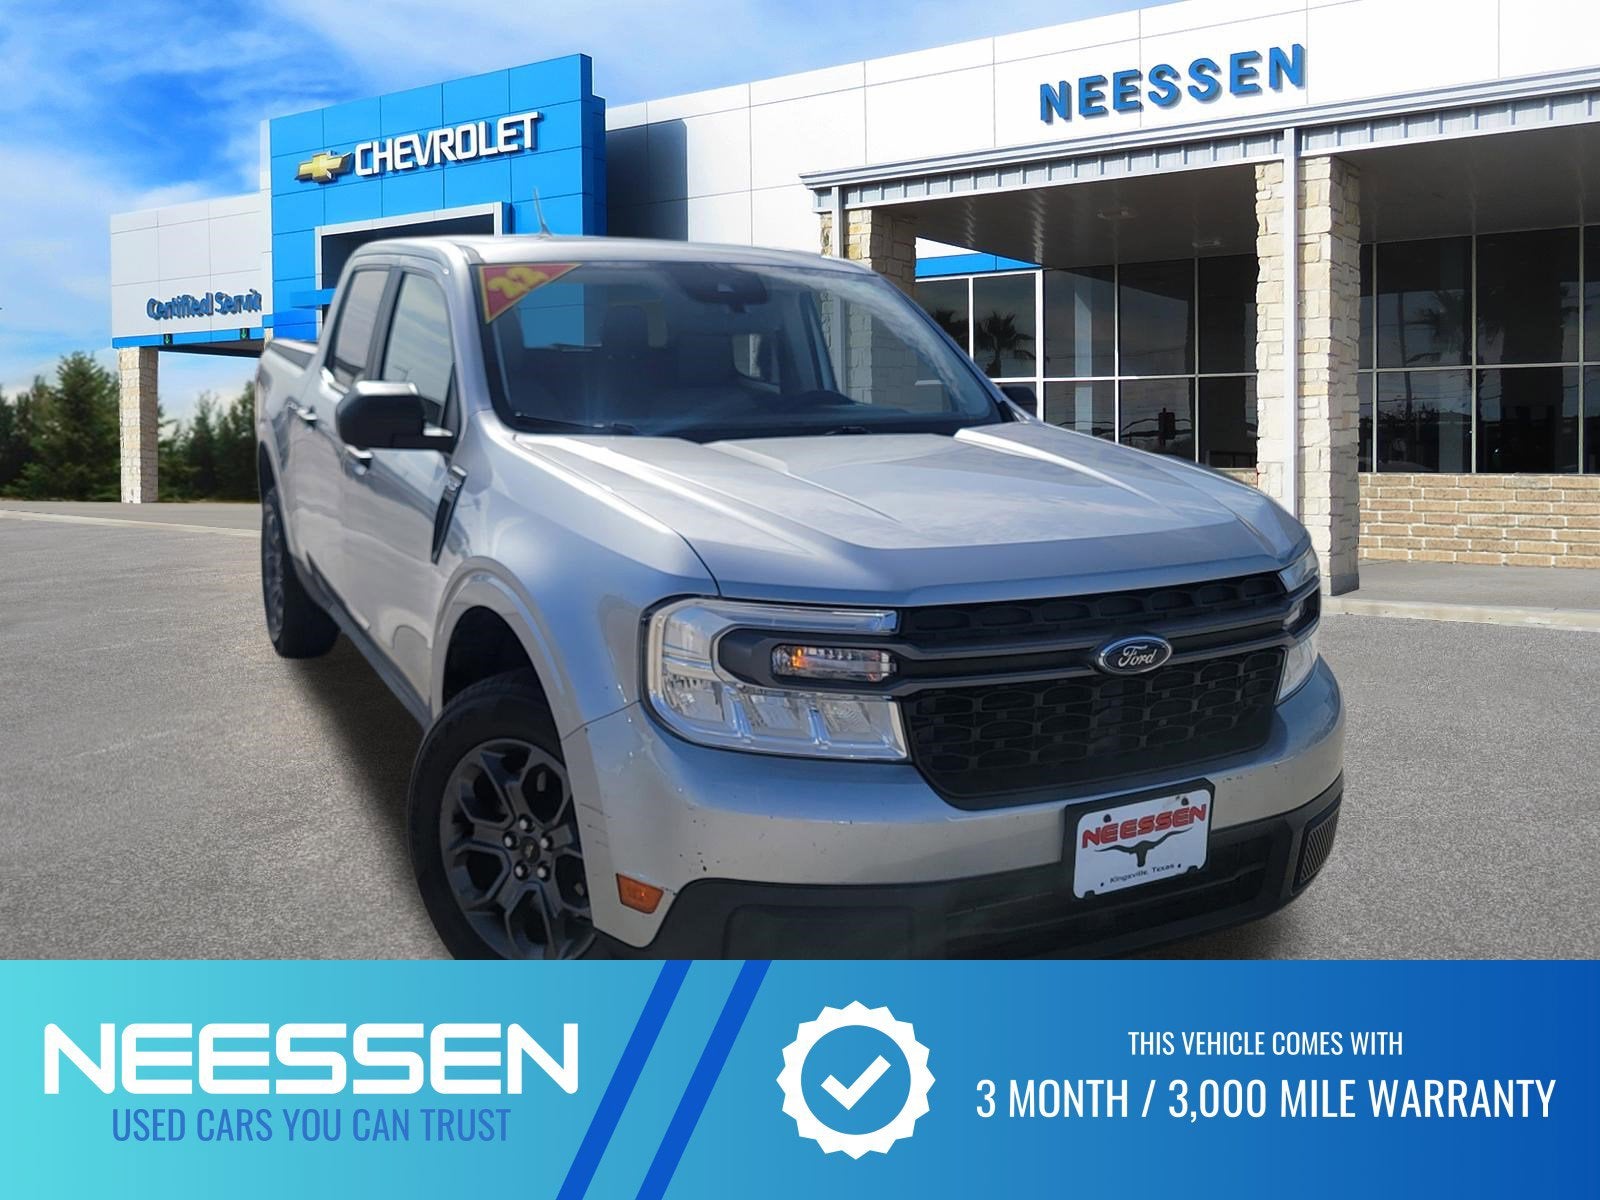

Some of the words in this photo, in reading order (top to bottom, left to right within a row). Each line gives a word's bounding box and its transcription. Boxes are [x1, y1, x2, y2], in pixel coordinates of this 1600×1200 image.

[1039, 43, 1305, 124] NEESSEN
[354, 110, 541, 177] CHEVROLET
[487, 266, 549, 299] 22
[147, 296, 214, 320] Certified
[1118, 645, 1155, 666] Ford
[1082, 804, 1207, 848] NEESSEN
[1152, 863, 1175, 873] Texas
